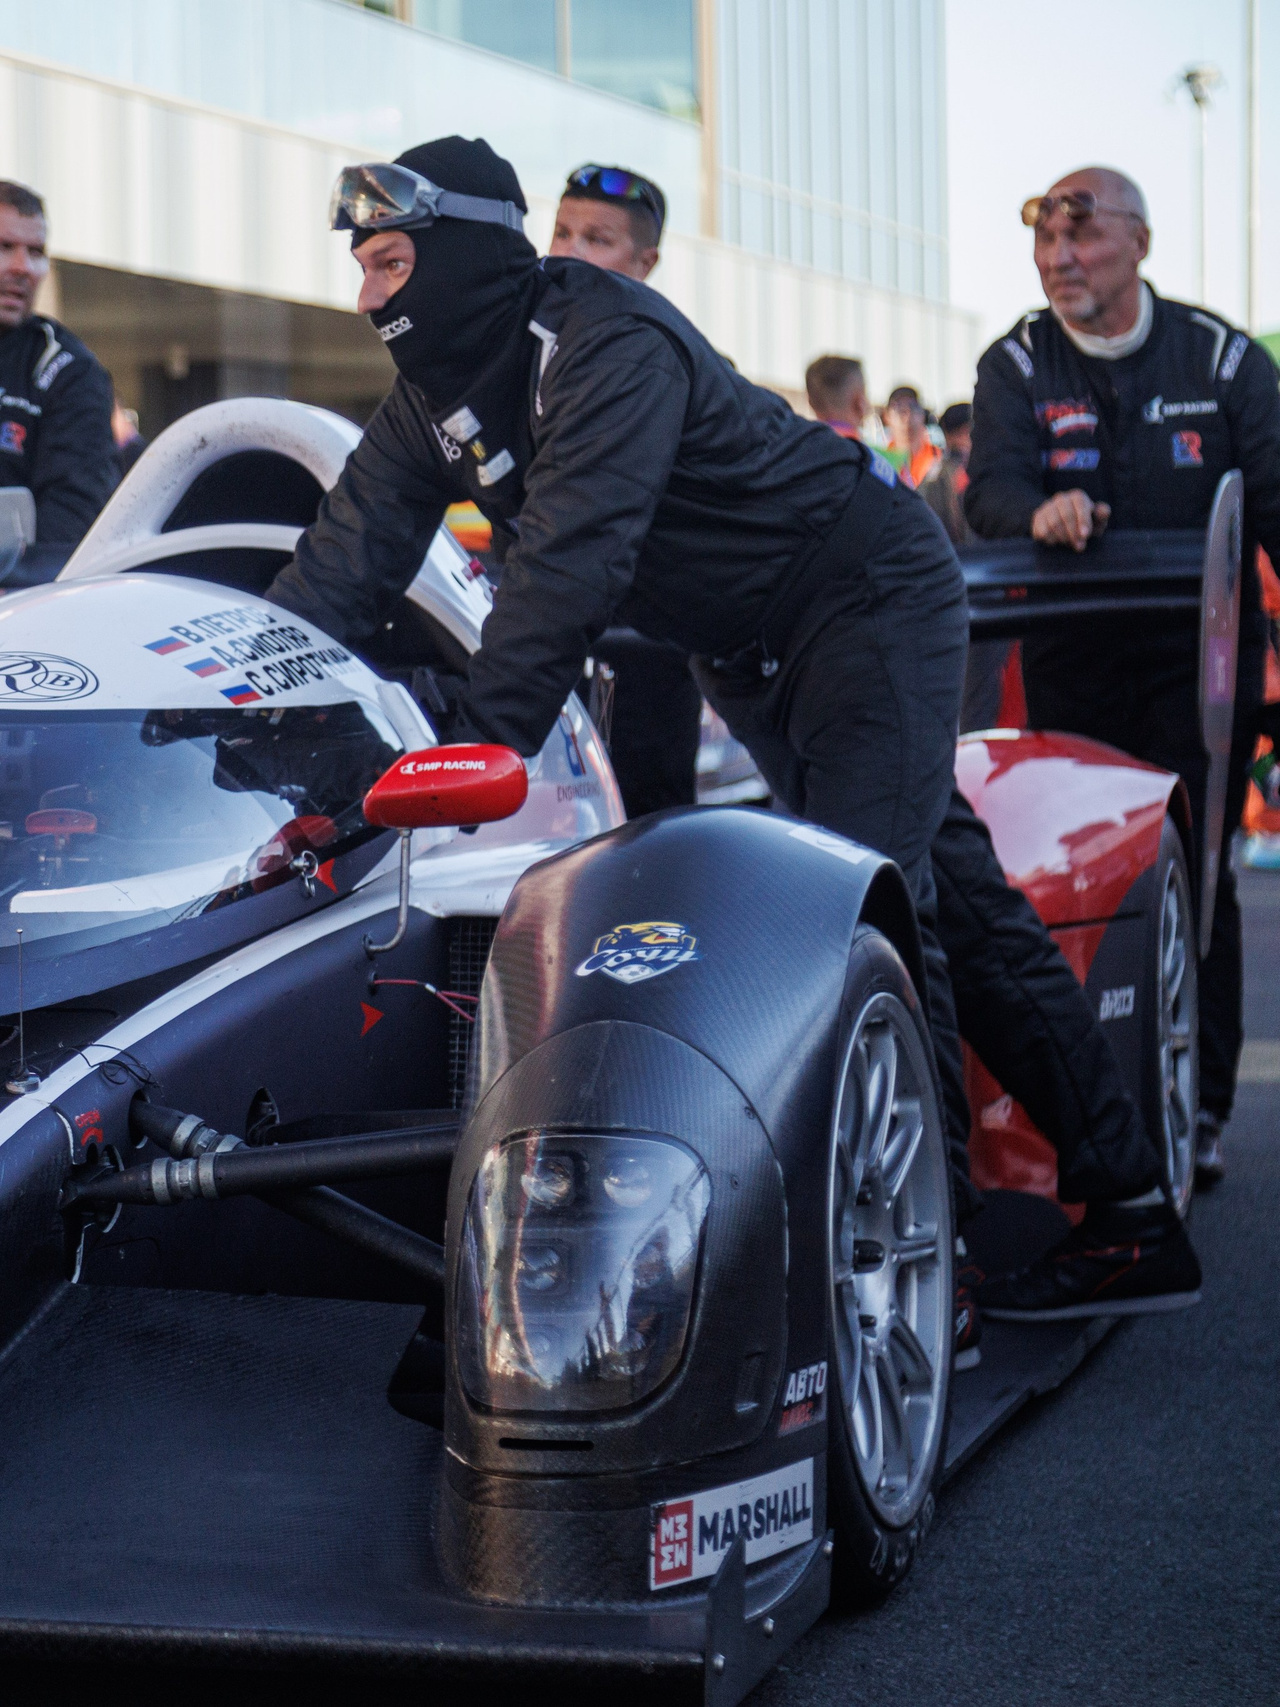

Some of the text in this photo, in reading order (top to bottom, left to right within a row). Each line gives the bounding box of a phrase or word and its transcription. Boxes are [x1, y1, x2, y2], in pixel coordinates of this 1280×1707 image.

[416, 760, 486, 773] SMP RACING
[698, 1482, 811, 1556] MARSHALL
